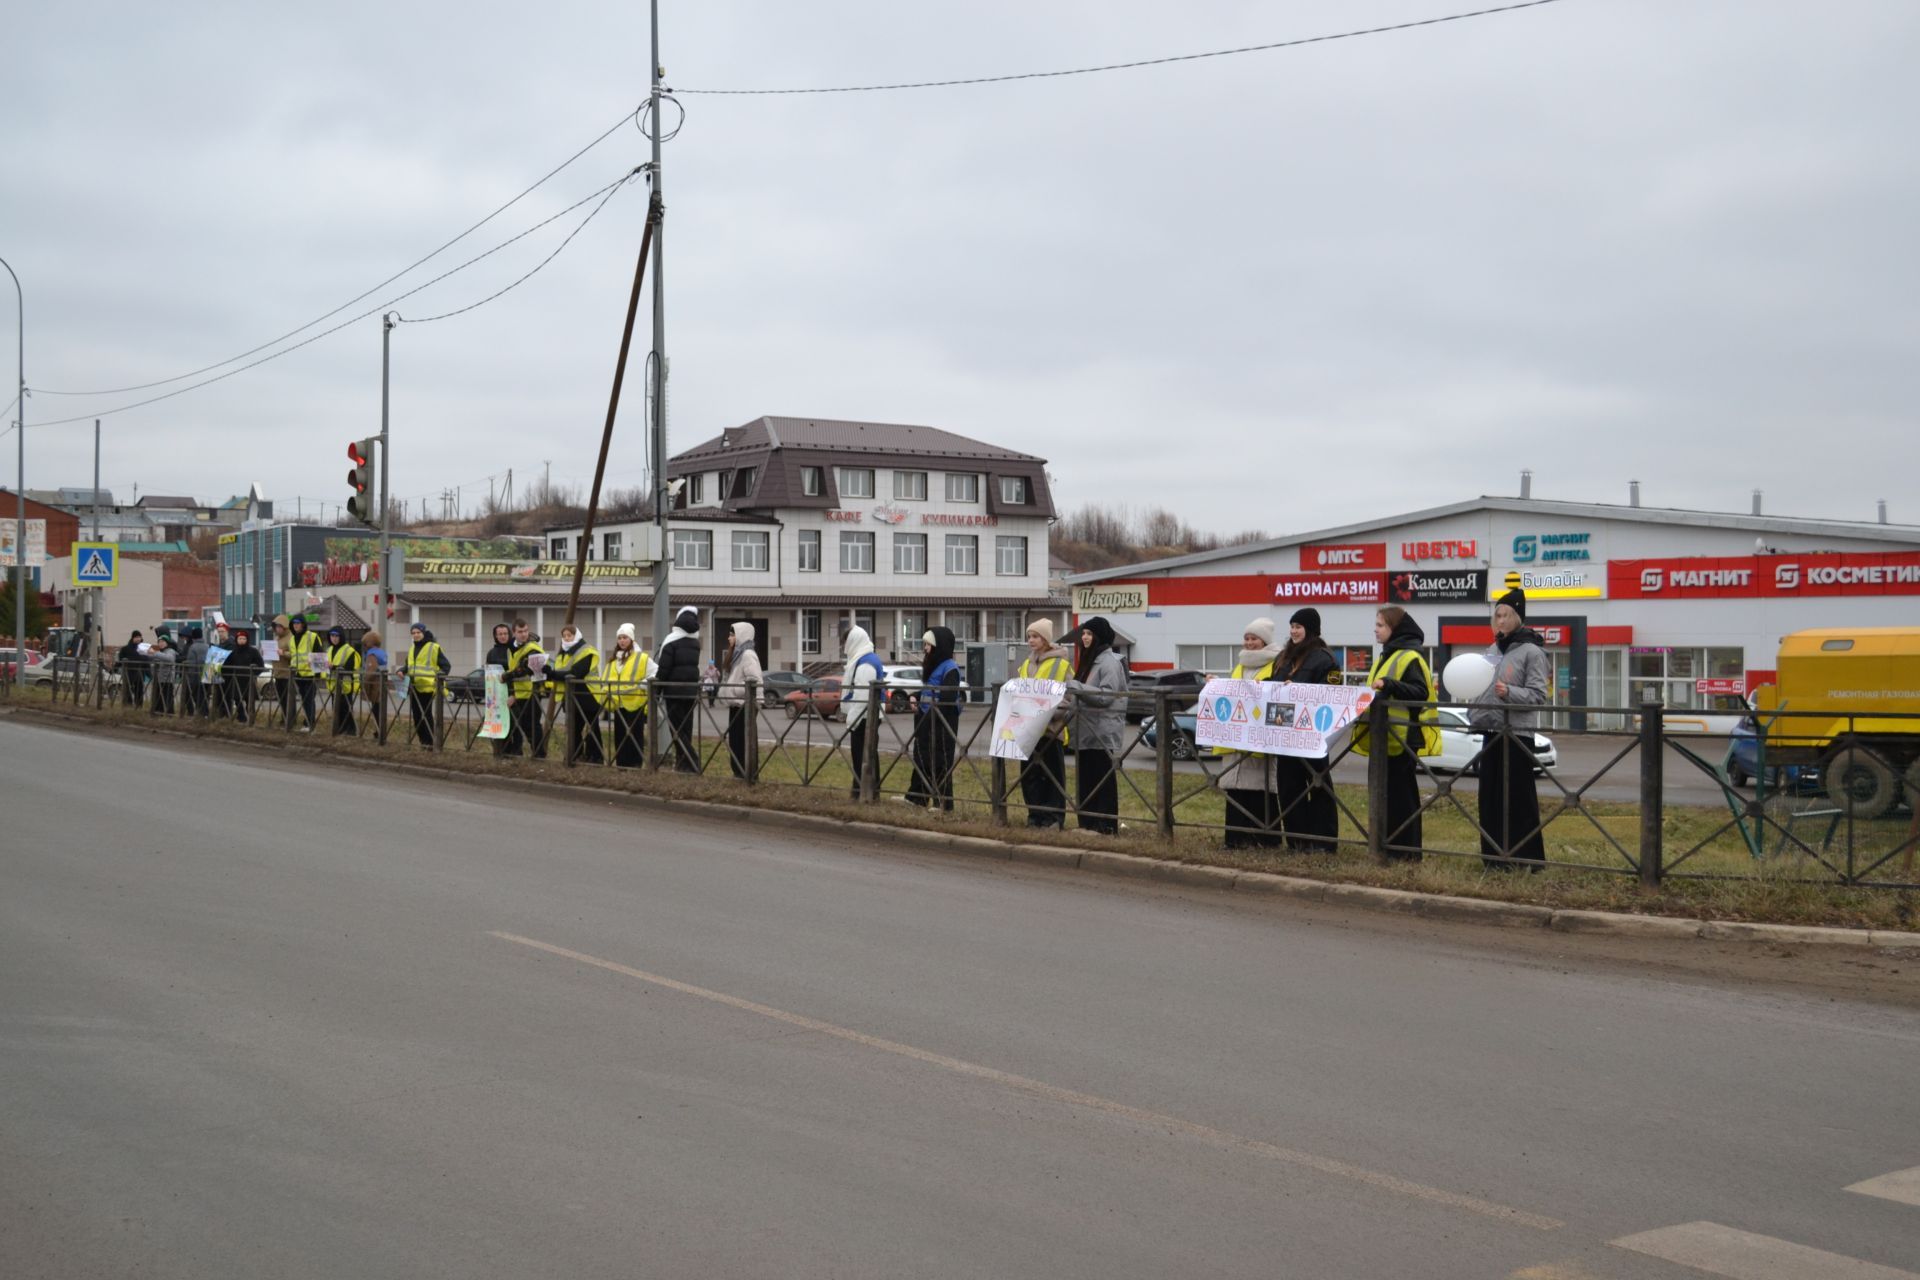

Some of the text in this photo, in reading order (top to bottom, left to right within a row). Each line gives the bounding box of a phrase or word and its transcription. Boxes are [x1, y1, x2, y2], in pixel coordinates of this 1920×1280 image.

[825, 511, 862, 523] КАФЕ
[922, 514, 998, 528] КУЛИНАРИЯ
[1541, 533, 1590, 545] МАГНИТ
[1328, 550, 1364, 564] МТС
[1402, 540, 1476, 564] ЦВЕТЫ
[1542, 549, 1590, 560] АПТЕКА
[422, 559, 506, 578] Пекарня
[1523, 570, 1582, 588] Билайн
[1670, 570, 1751, 587] МАГНИТ
[1275, 581, 1378, 597] АВТОМАГАЗИН
[1079, 588, 1142, 612] Пекарня
[1197, 722, 1242, 743] БУДЬТЕ
